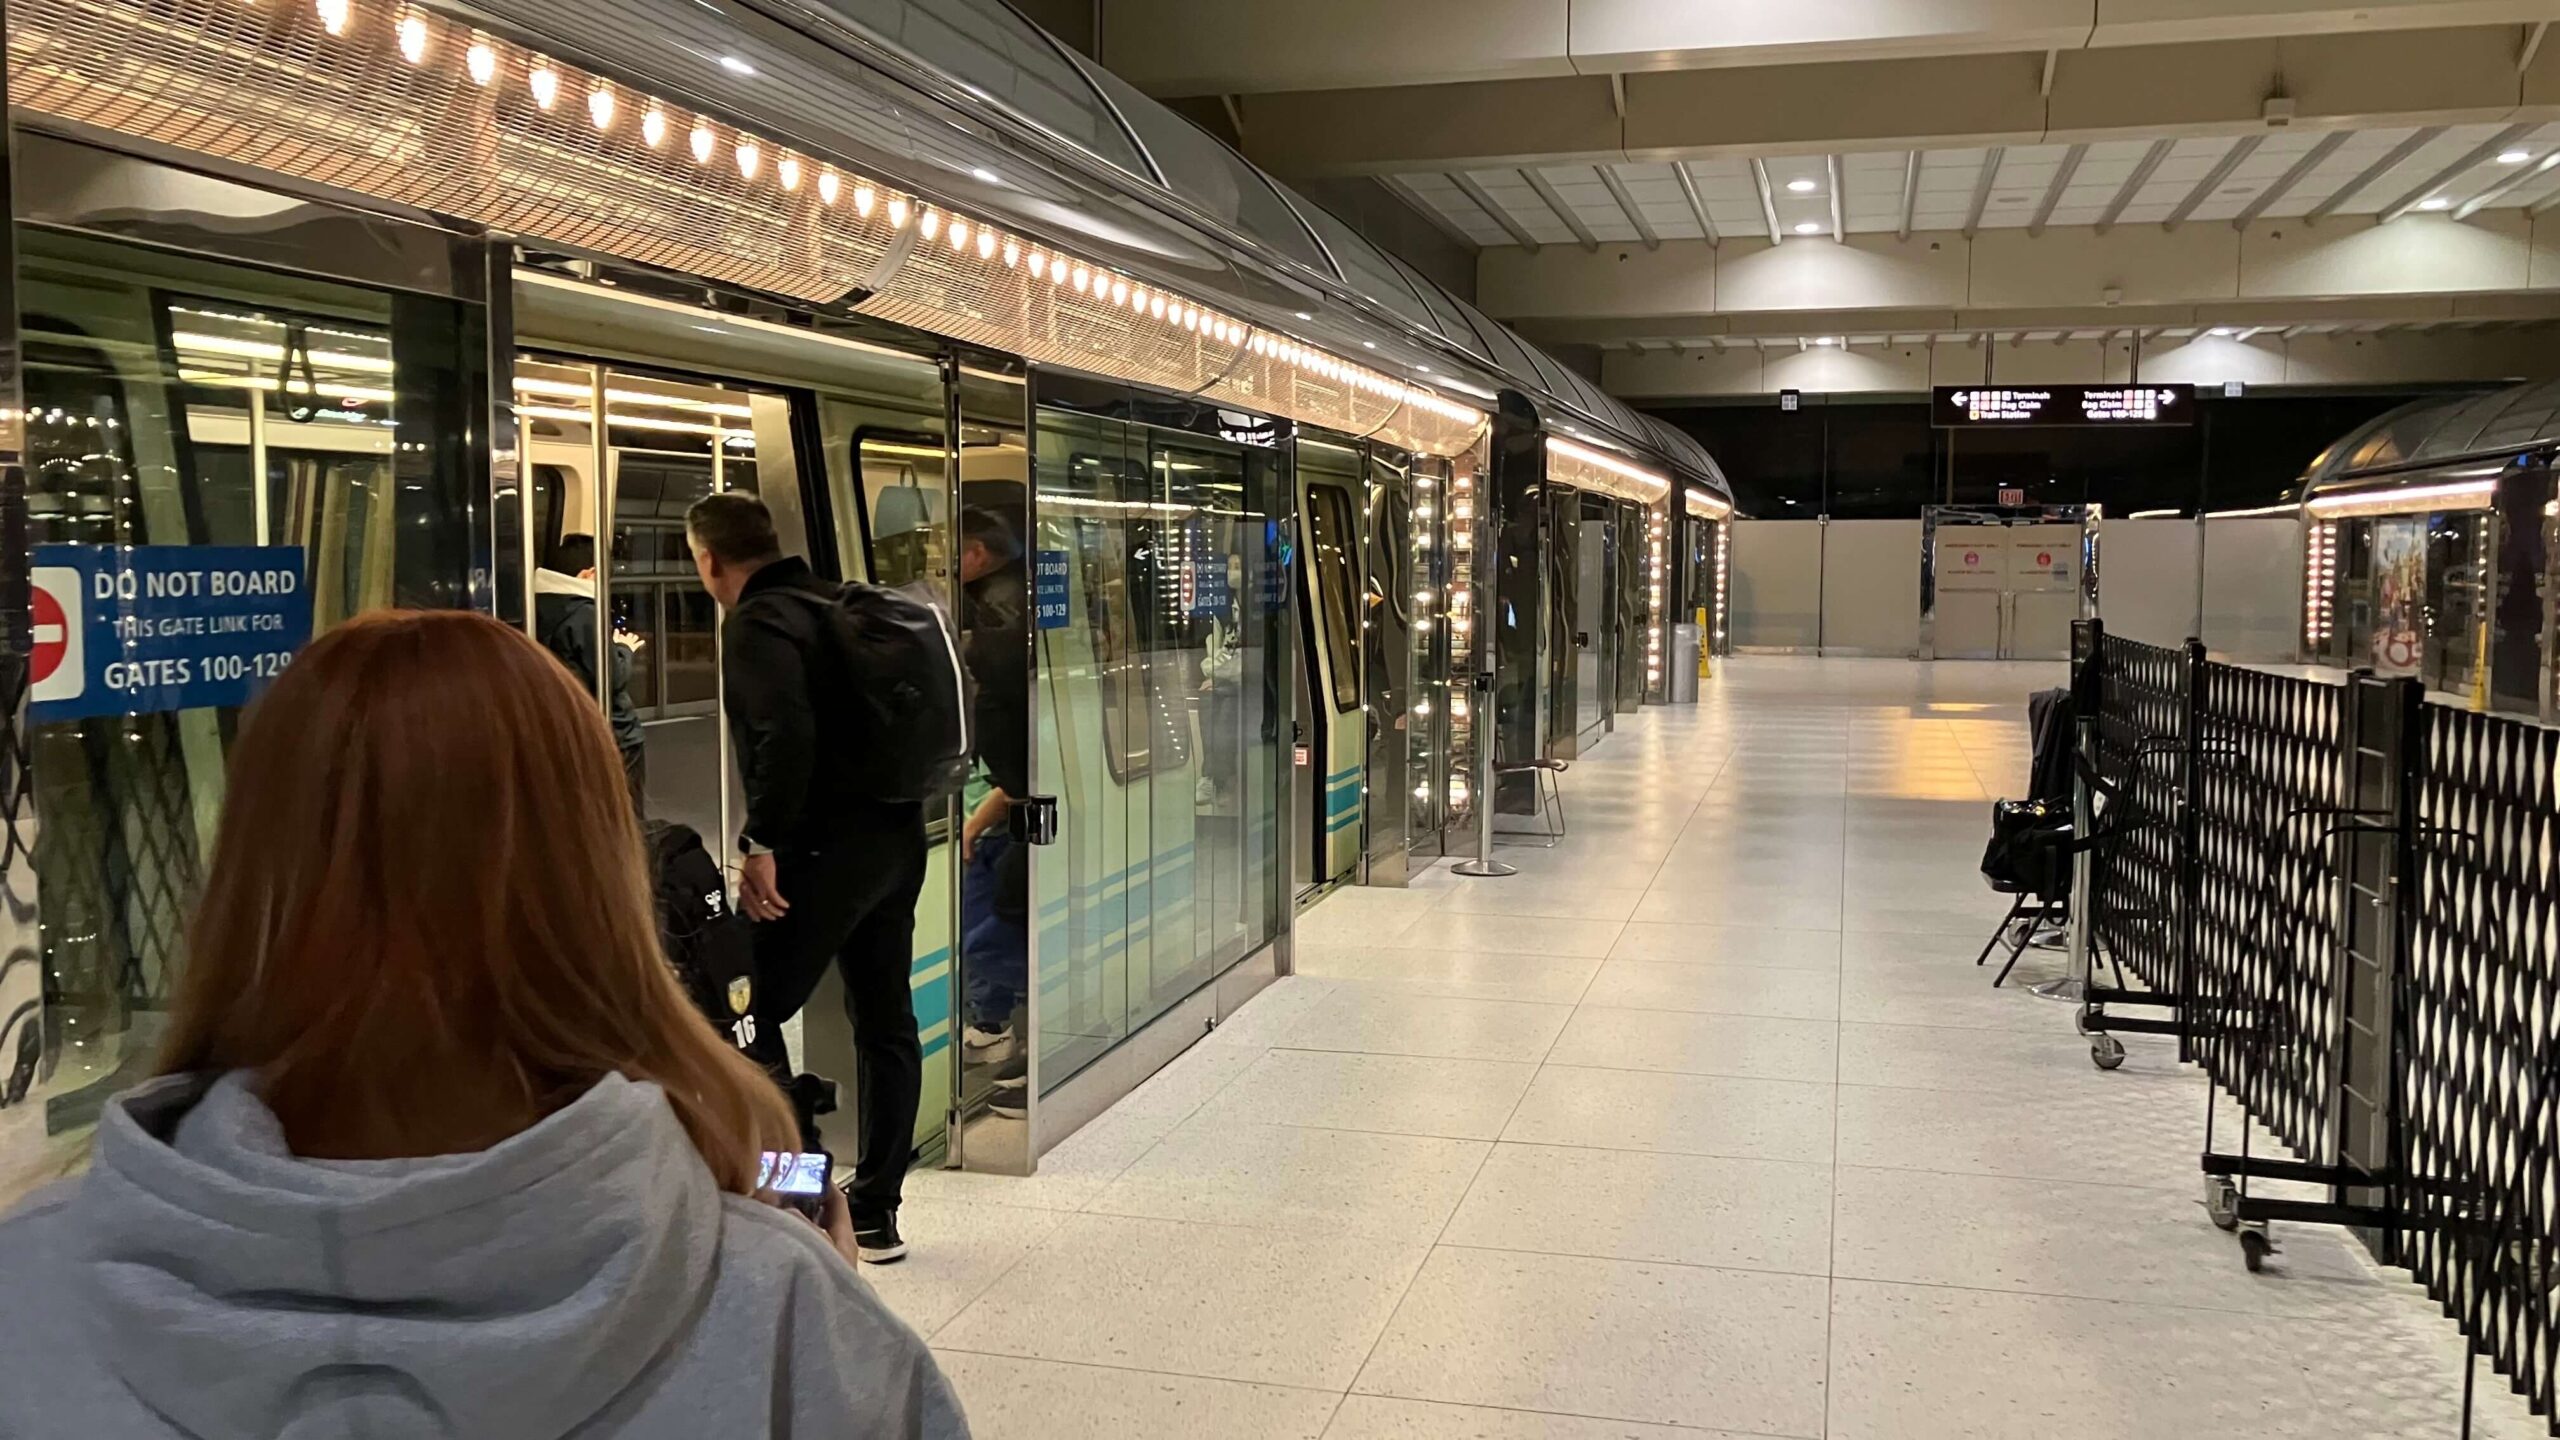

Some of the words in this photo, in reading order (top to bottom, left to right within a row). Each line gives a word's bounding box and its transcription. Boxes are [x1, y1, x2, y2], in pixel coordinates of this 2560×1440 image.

[2012, 391, 2051, 400] Terminals
[2083, 391, 2122, 400] Terminals
[2001, 401, 2017, 410] Bag
[2018, 400, 2041, 409] Claim
[2099, 400, 2122, 409] Claim
[1980, 410, 2000, 419] Train
[2001, 410, 2031, 419] Station
[2086, 409, 2110, 419] Gates
[94, 572, 138, 599] DO
[147, 571, 203, 597] NOT
[211, 570, 296, 596] BOARD
[112, 619, 154, 639] THIS
[159, 617, 204, 636] GATE
[210, 615, 248, 634] LINK
[252, 614, 285, 631] FOR
[104, 658, 191, 690] GATES
[731, 1014, 757, 1049] 16
